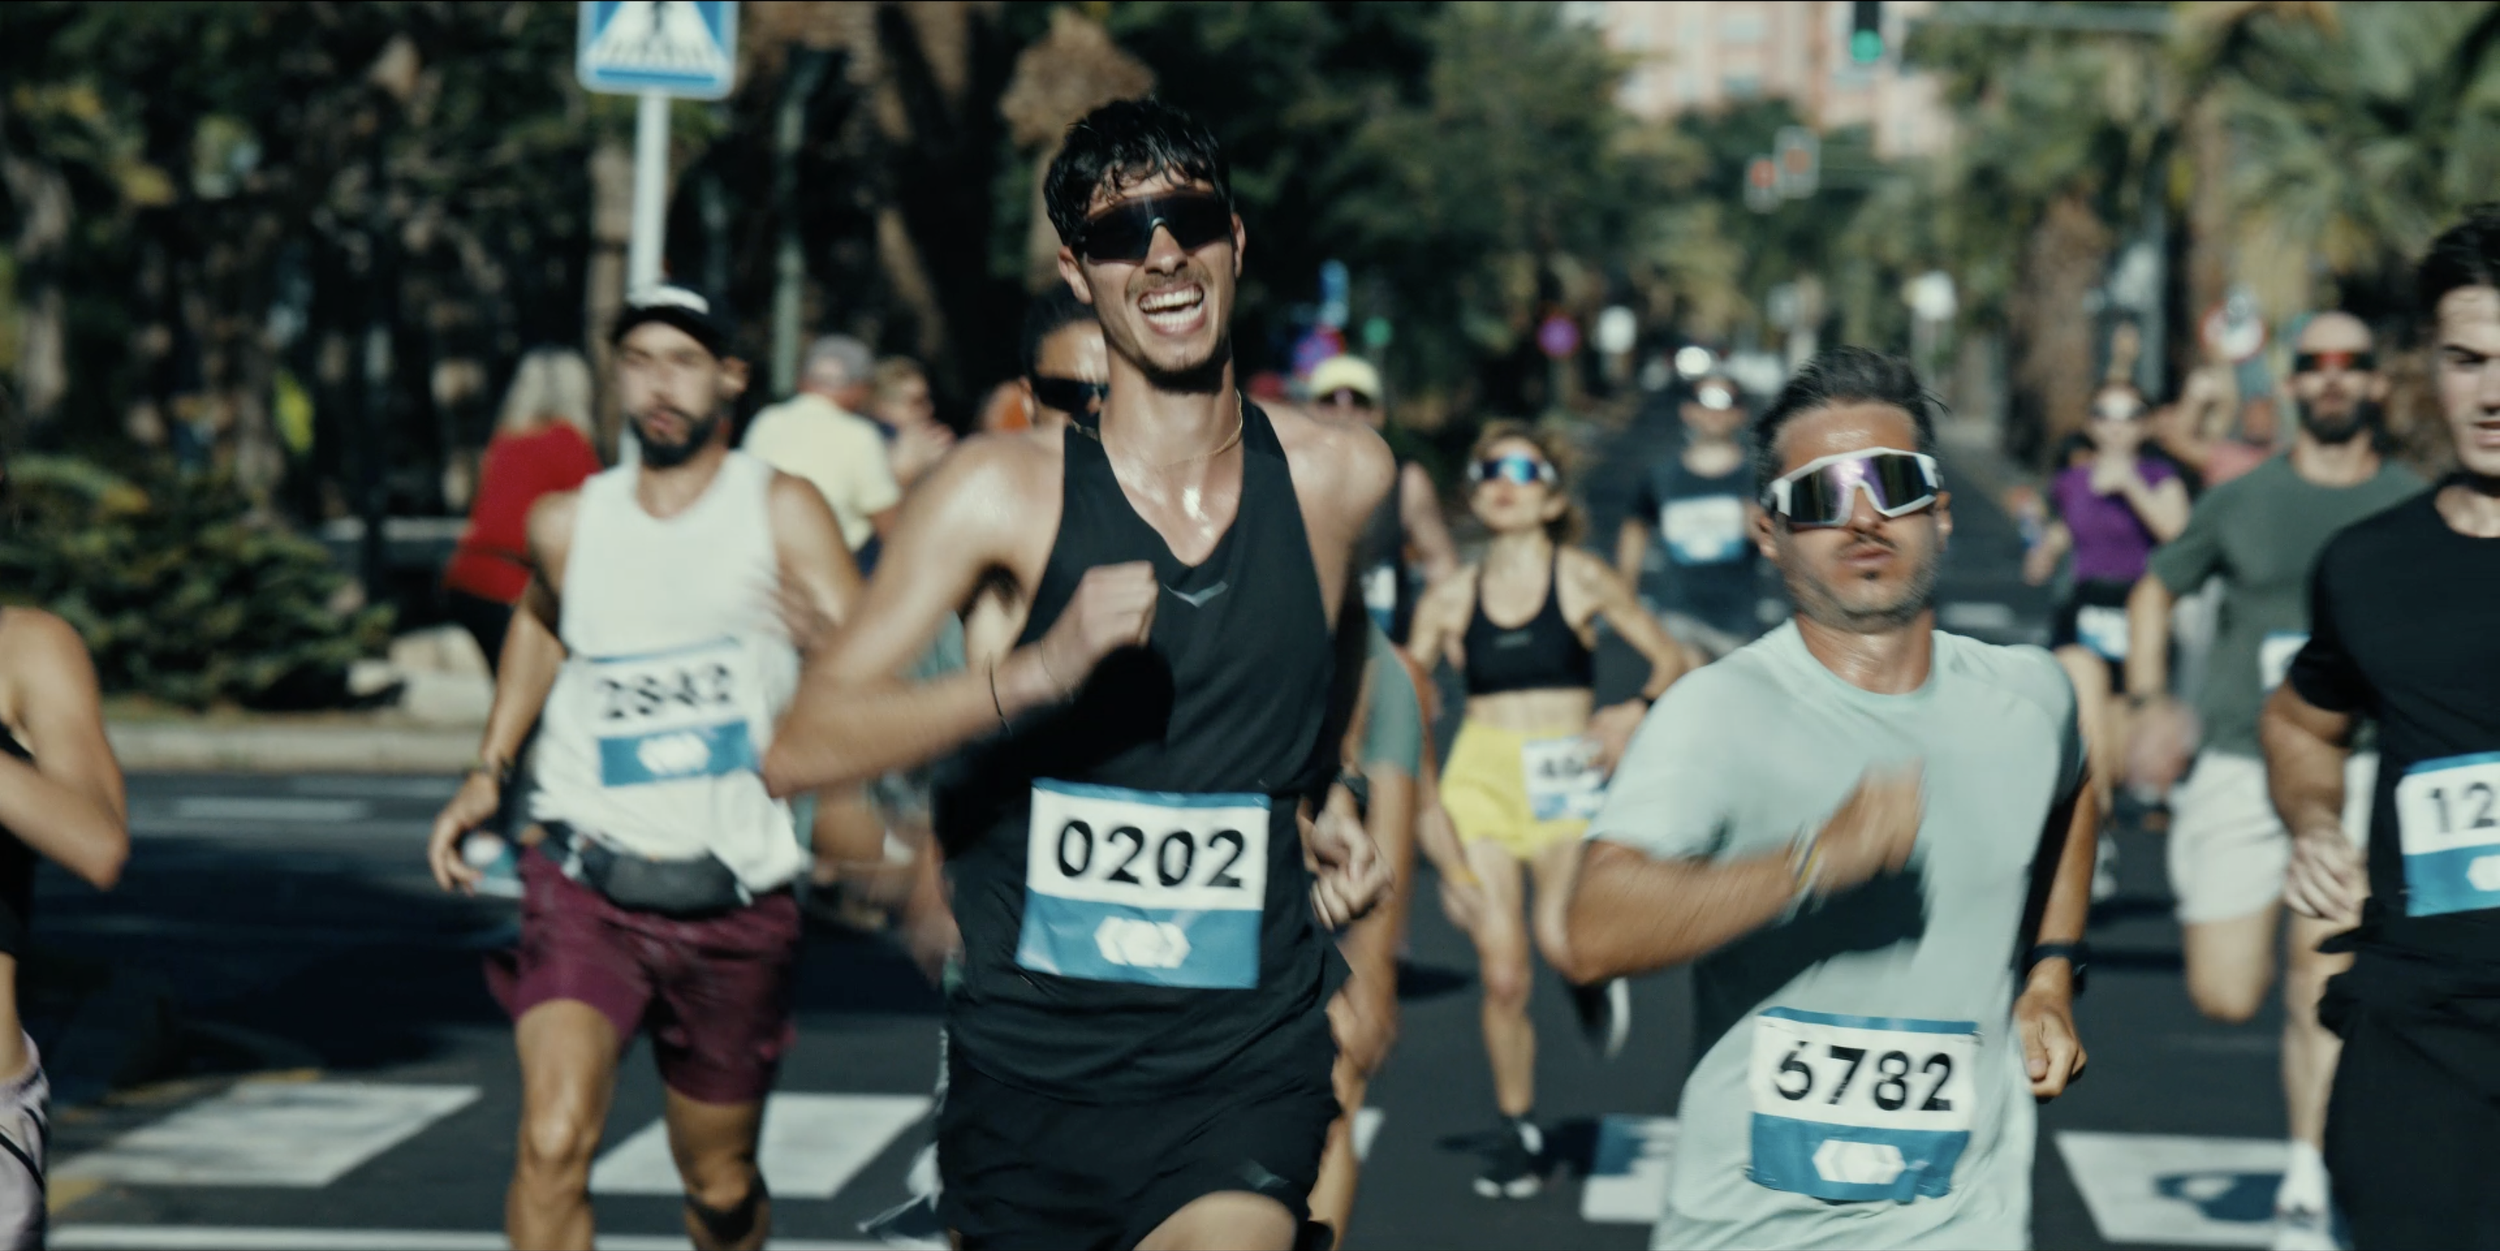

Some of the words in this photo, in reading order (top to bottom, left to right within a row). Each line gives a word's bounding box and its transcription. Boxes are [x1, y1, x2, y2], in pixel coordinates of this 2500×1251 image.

[602, 664, 730, 719] 2842
[1058, 819, 1244, 888] 0202
[1775, 1039, 1953, 1112] 6782
